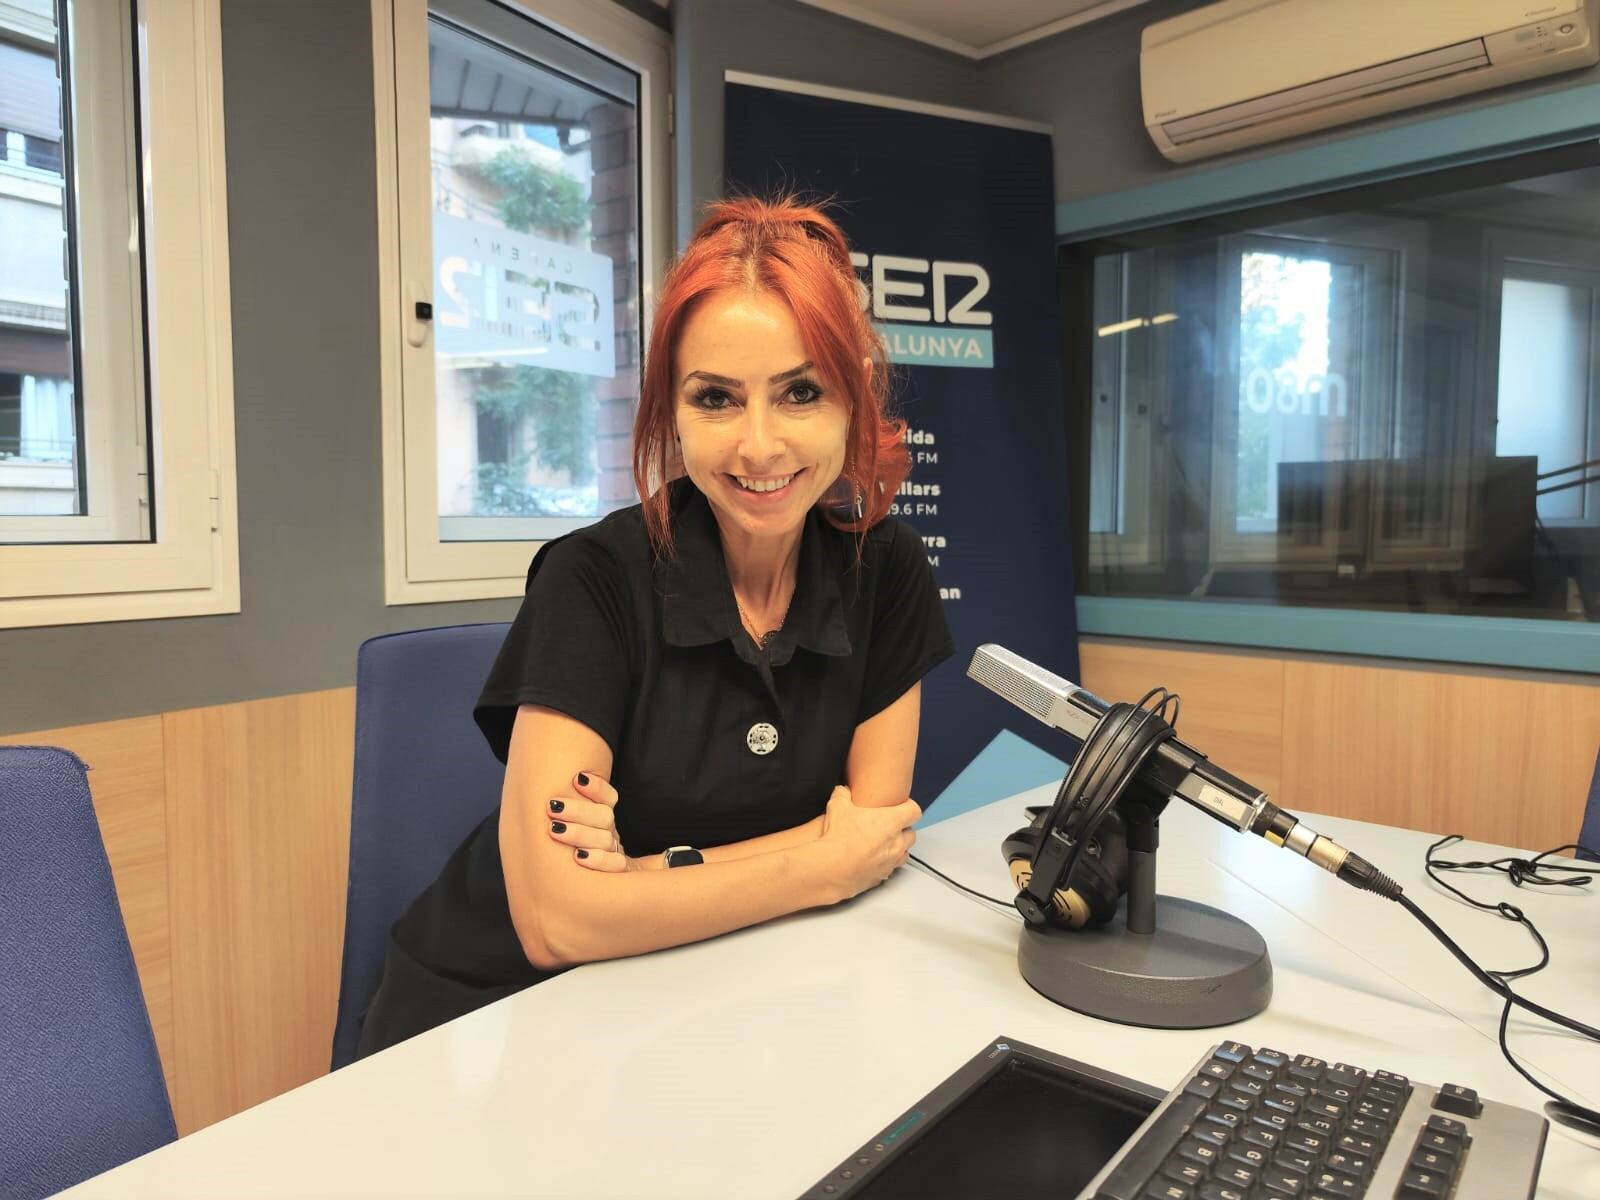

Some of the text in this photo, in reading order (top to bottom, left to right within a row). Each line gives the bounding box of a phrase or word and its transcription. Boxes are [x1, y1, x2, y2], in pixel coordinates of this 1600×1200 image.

[850, 252, 993, 325] ER
[917, 452, 939, 464] FM
[916, 503, 938, 516] FM
[1223, 1113, 1237, 1121] C
[1271, 1115, 1285, 1124] D
[1315, 1121, 1330, 1129] E
[1211, 1131, 1226, 1139] V
[1260, 1131, 1274, 1141] F
[1304, 1137, 1319, 1146] R
[1197, 1147, 1213, 1157] B
[1246, 1150, 1262, 1160] G
[1295, 1158, 1310, 1166] T
[1182, 1166, 1199, 1177] N
[1234, 1169, 1251, 1180] H
[1283, 1178, 1299, 1187] Y
[1166, 1187, 1184, 1198] M
